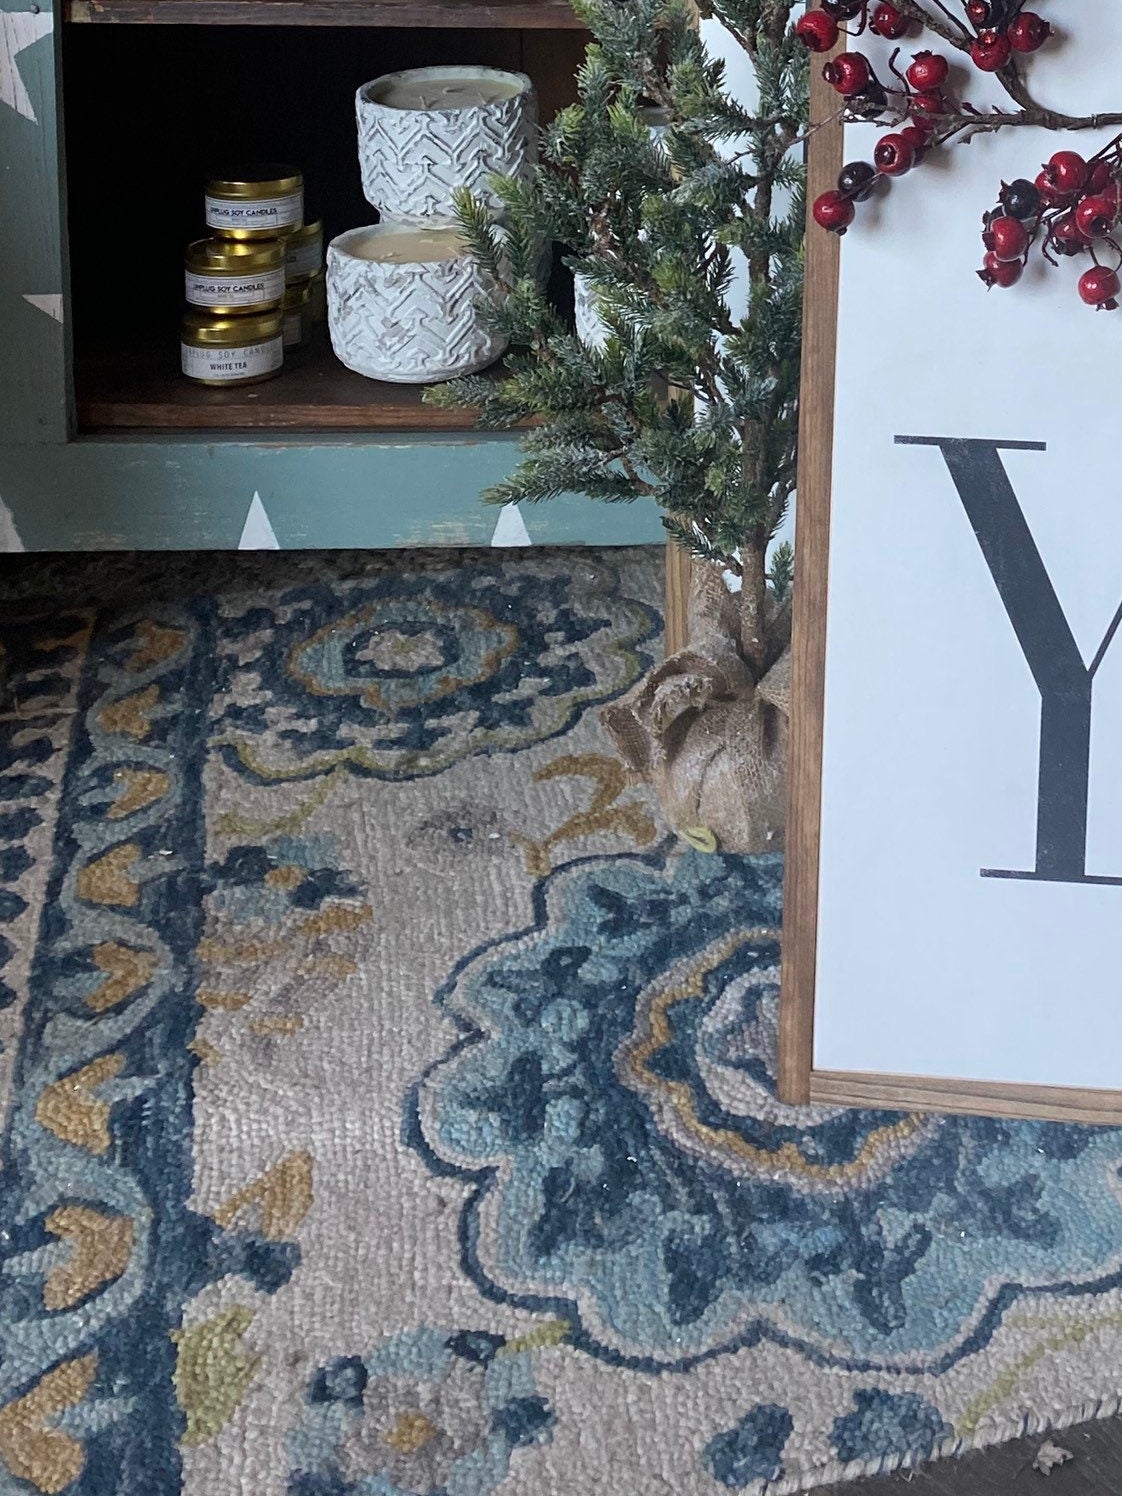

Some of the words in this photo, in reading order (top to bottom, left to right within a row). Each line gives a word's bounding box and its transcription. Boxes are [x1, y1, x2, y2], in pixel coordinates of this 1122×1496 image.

[231, 208, 245, 216] SOY
[245, 207, 278, 216] CANDLES
[217, 284, 232, 292] SOY
[232, 283, 265, 292] CANDLES
[216, 348, 236, 359] SOY
[209, 362, 233, 371] WHITE
[235, 361, 247, 370] TEA
